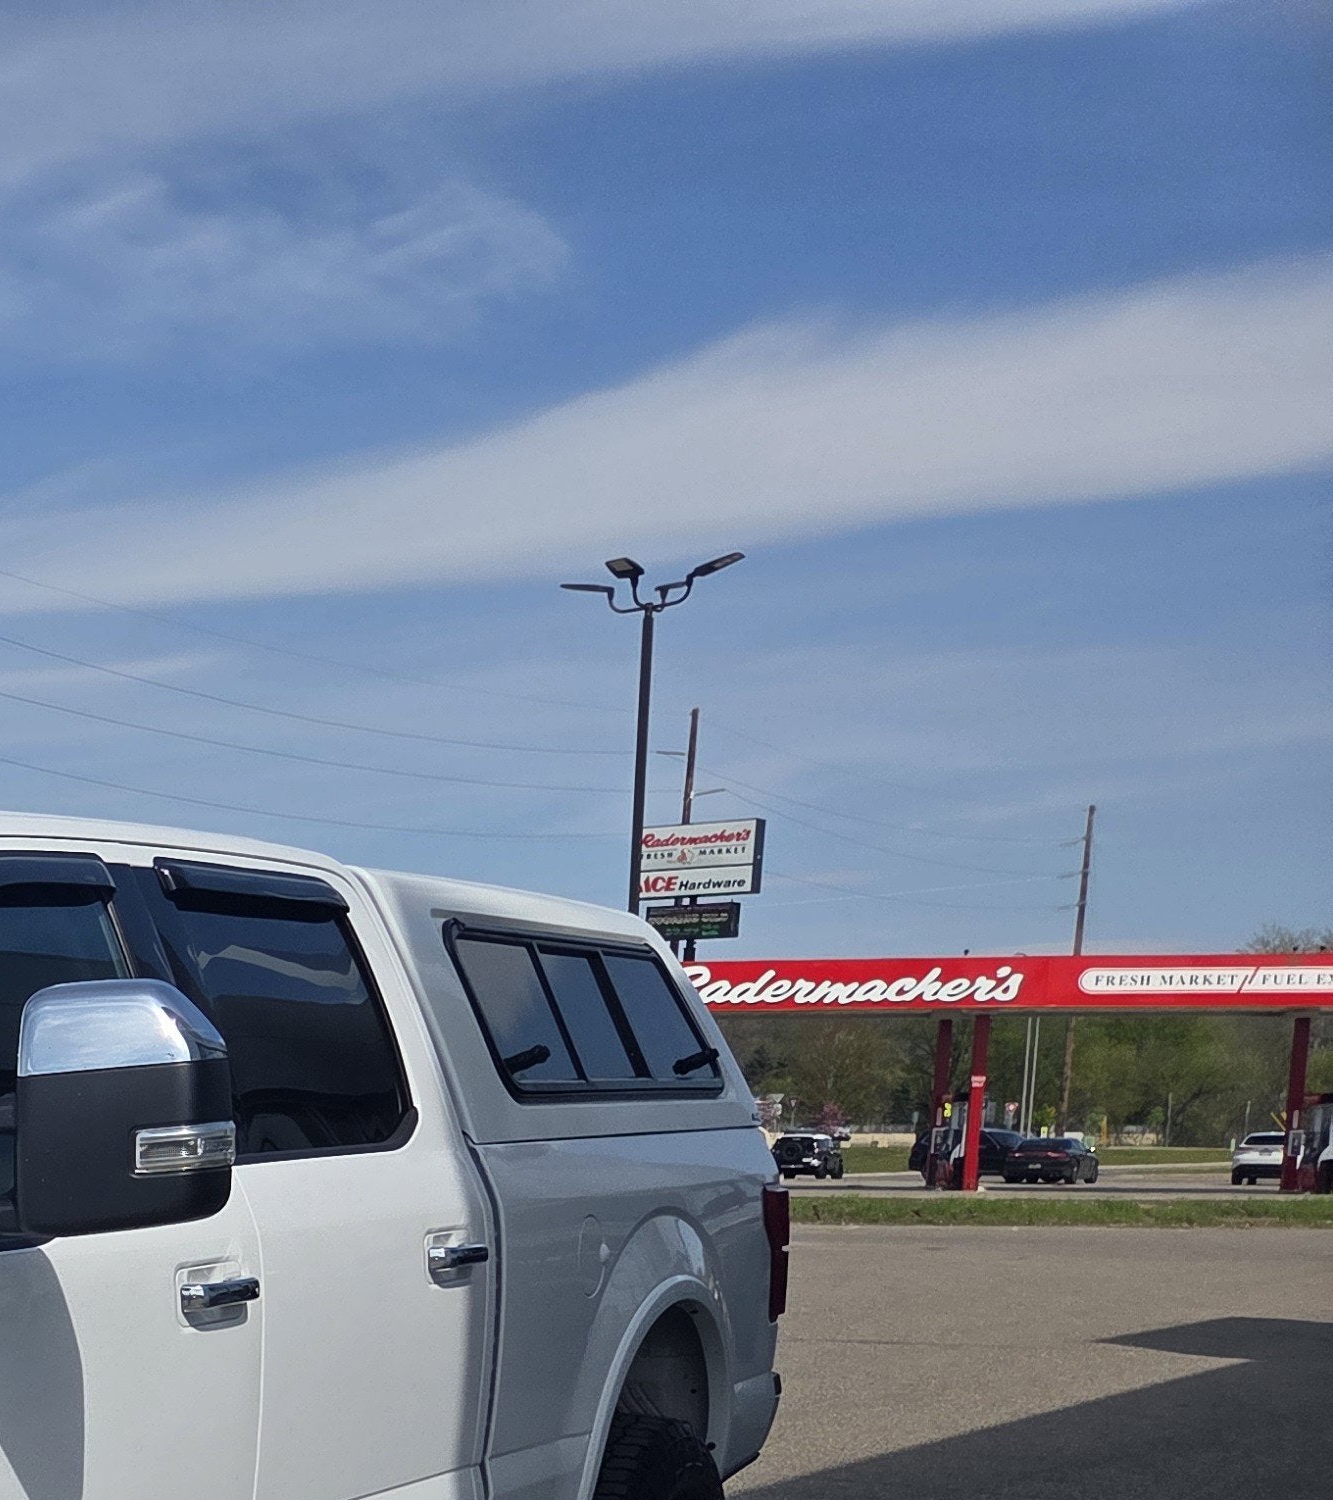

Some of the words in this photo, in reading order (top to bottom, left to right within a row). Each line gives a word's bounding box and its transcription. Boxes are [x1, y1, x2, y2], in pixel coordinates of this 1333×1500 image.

[640, 829, 751, 848] Radermacher's
[698, 847, 746, 856] MARKET
[678, 879, 746, 891] Hardware
[1094, 974, 1151, 986] FRESH
[1159, 973, 1238, 986] MARKET
[1261, 973, 1309, 985] FUEL
